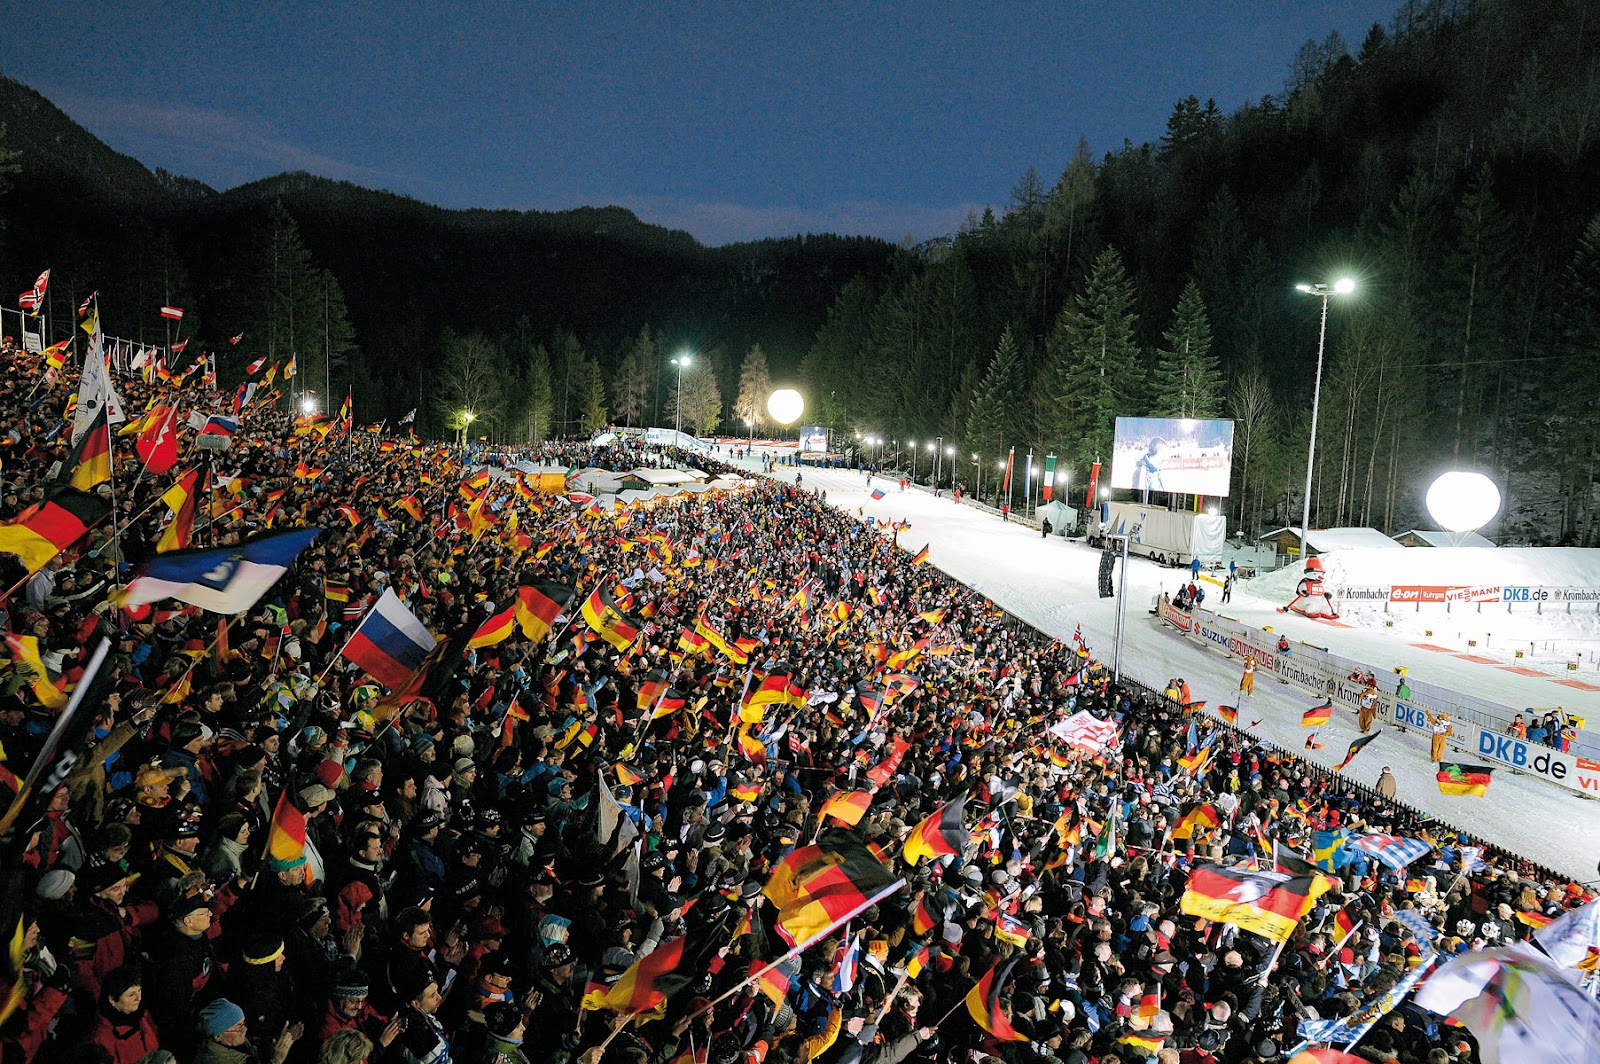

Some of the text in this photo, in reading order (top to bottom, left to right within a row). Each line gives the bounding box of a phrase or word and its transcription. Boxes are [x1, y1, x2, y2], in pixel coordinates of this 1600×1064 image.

[1346, 587, 1390, 600] Krombacher
[1503, 588, 1549, 601] DKB.de
[1201, 627, 1231, 648] SUZUKI
[1230, 638, 1274, 669] BAUHAUS
[1281, 660, 1325, 691] Krombacher
[1395, 704, 1425, 728] DKB
[1479, 731, 1567, 780] DKB.de
